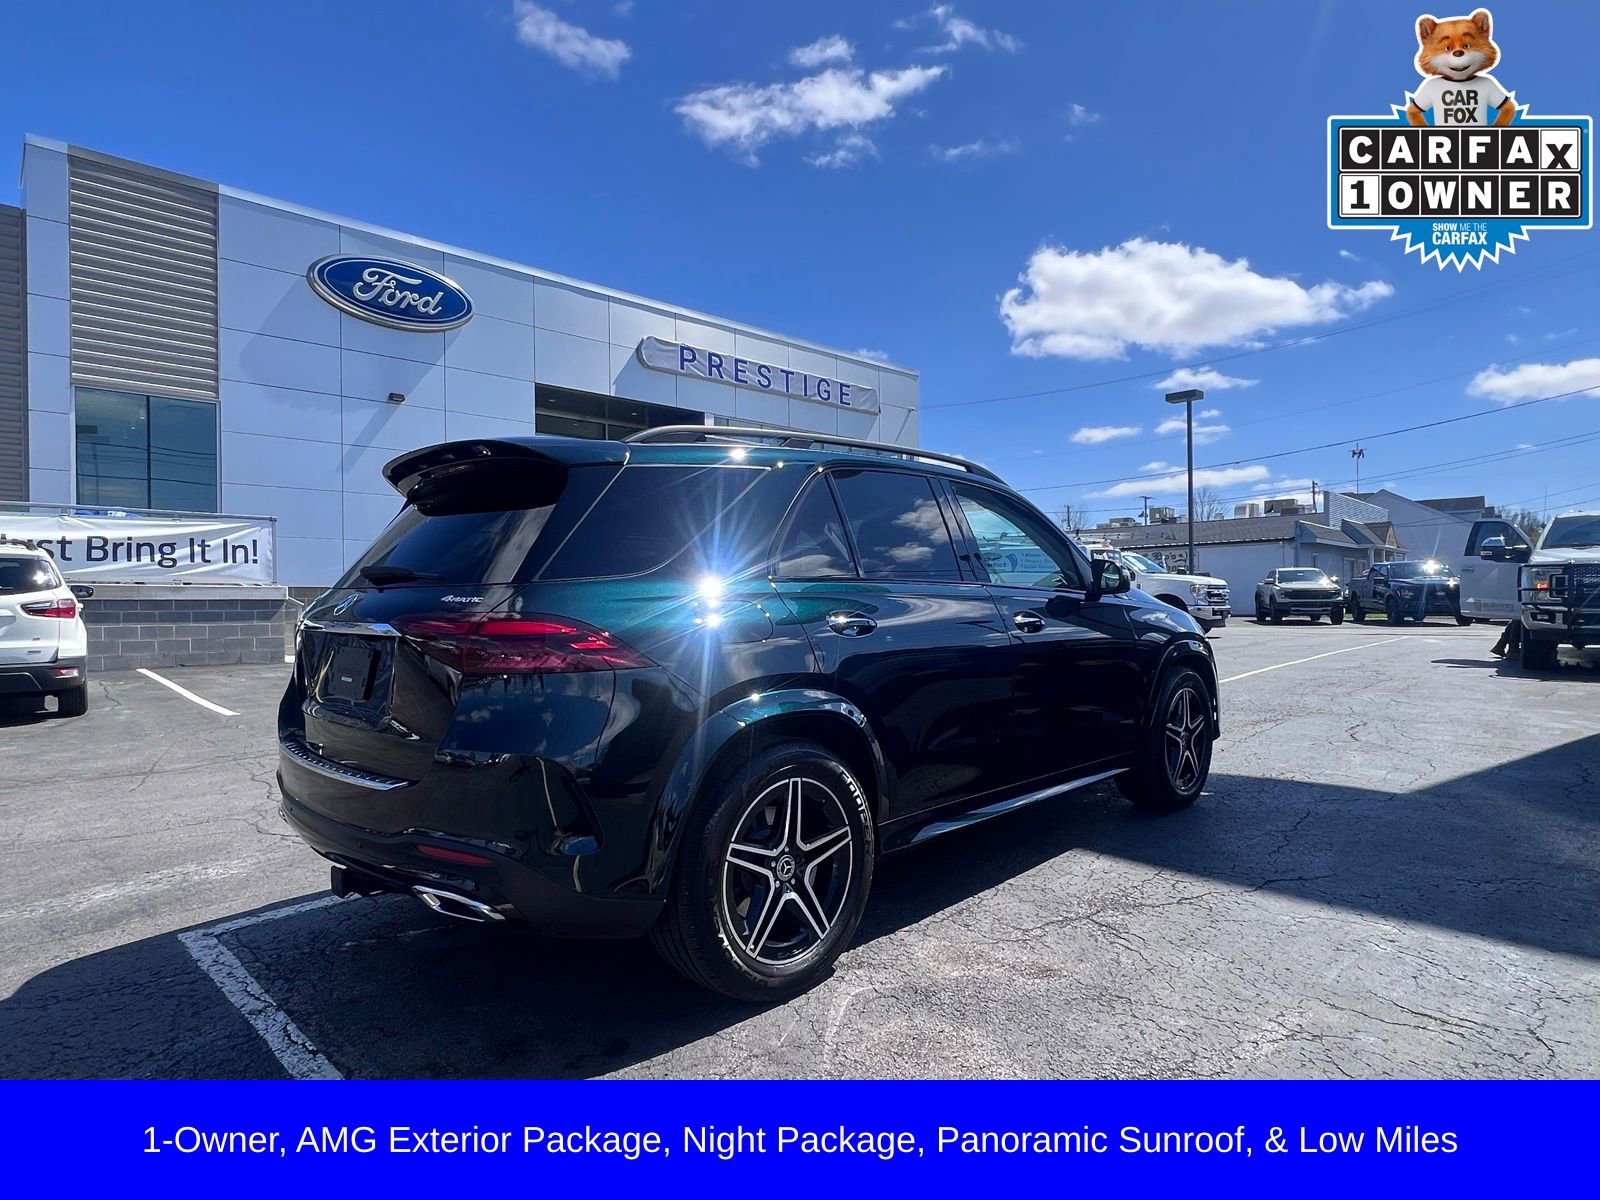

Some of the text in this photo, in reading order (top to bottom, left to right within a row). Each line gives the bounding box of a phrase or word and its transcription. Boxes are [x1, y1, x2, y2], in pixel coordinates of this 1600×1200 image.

[352, 267, 444, 316] Ford
[678, 344, 852, 406] PRESTIGE
[30, 535, 258, 568] st Bring It In!
